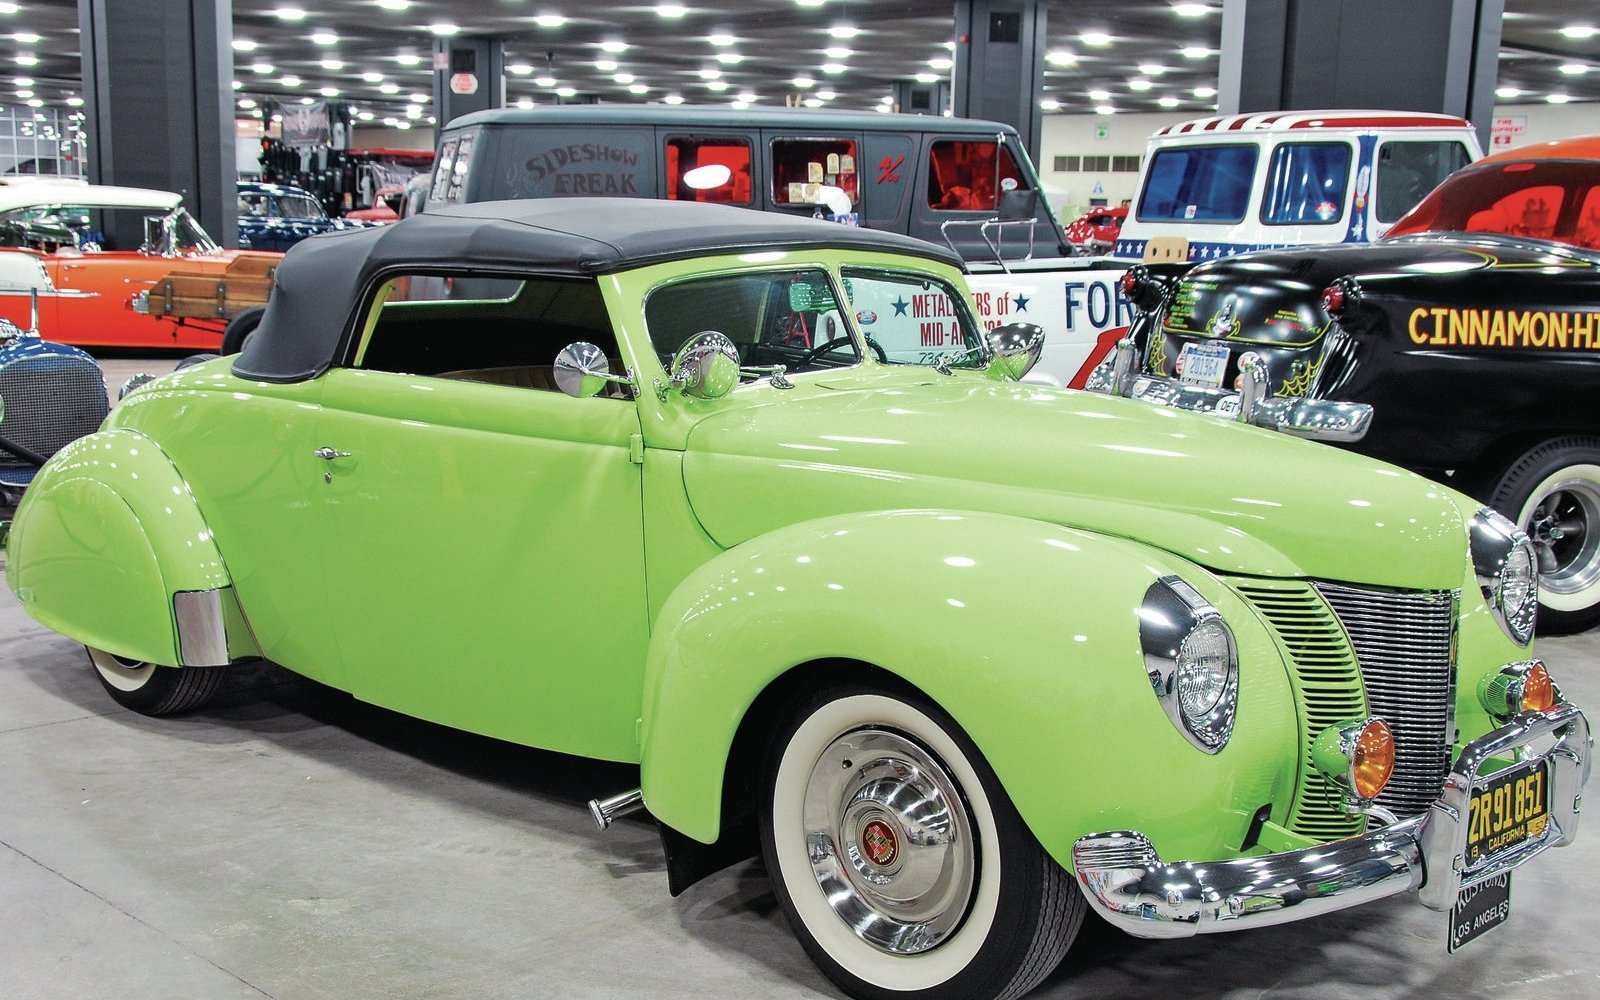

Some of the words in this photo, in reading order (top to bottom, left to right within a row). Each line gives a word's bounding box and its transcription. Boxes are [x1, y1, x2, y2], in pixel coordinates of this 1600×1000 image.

[525, 143, 640, 182] SIDESHOW
[551, 173, 639, 195] FREAK
[996, 292, 1010, 316] of
[1065, 281, 1135, 328] FOR
[1220, 400, 1239, 412] DET
[1488, 825, 1525, 851] CALIFORNIA
[1453, 921, 1470, 942] LOS
[1473, 899, 1509, 931] ANGELES
